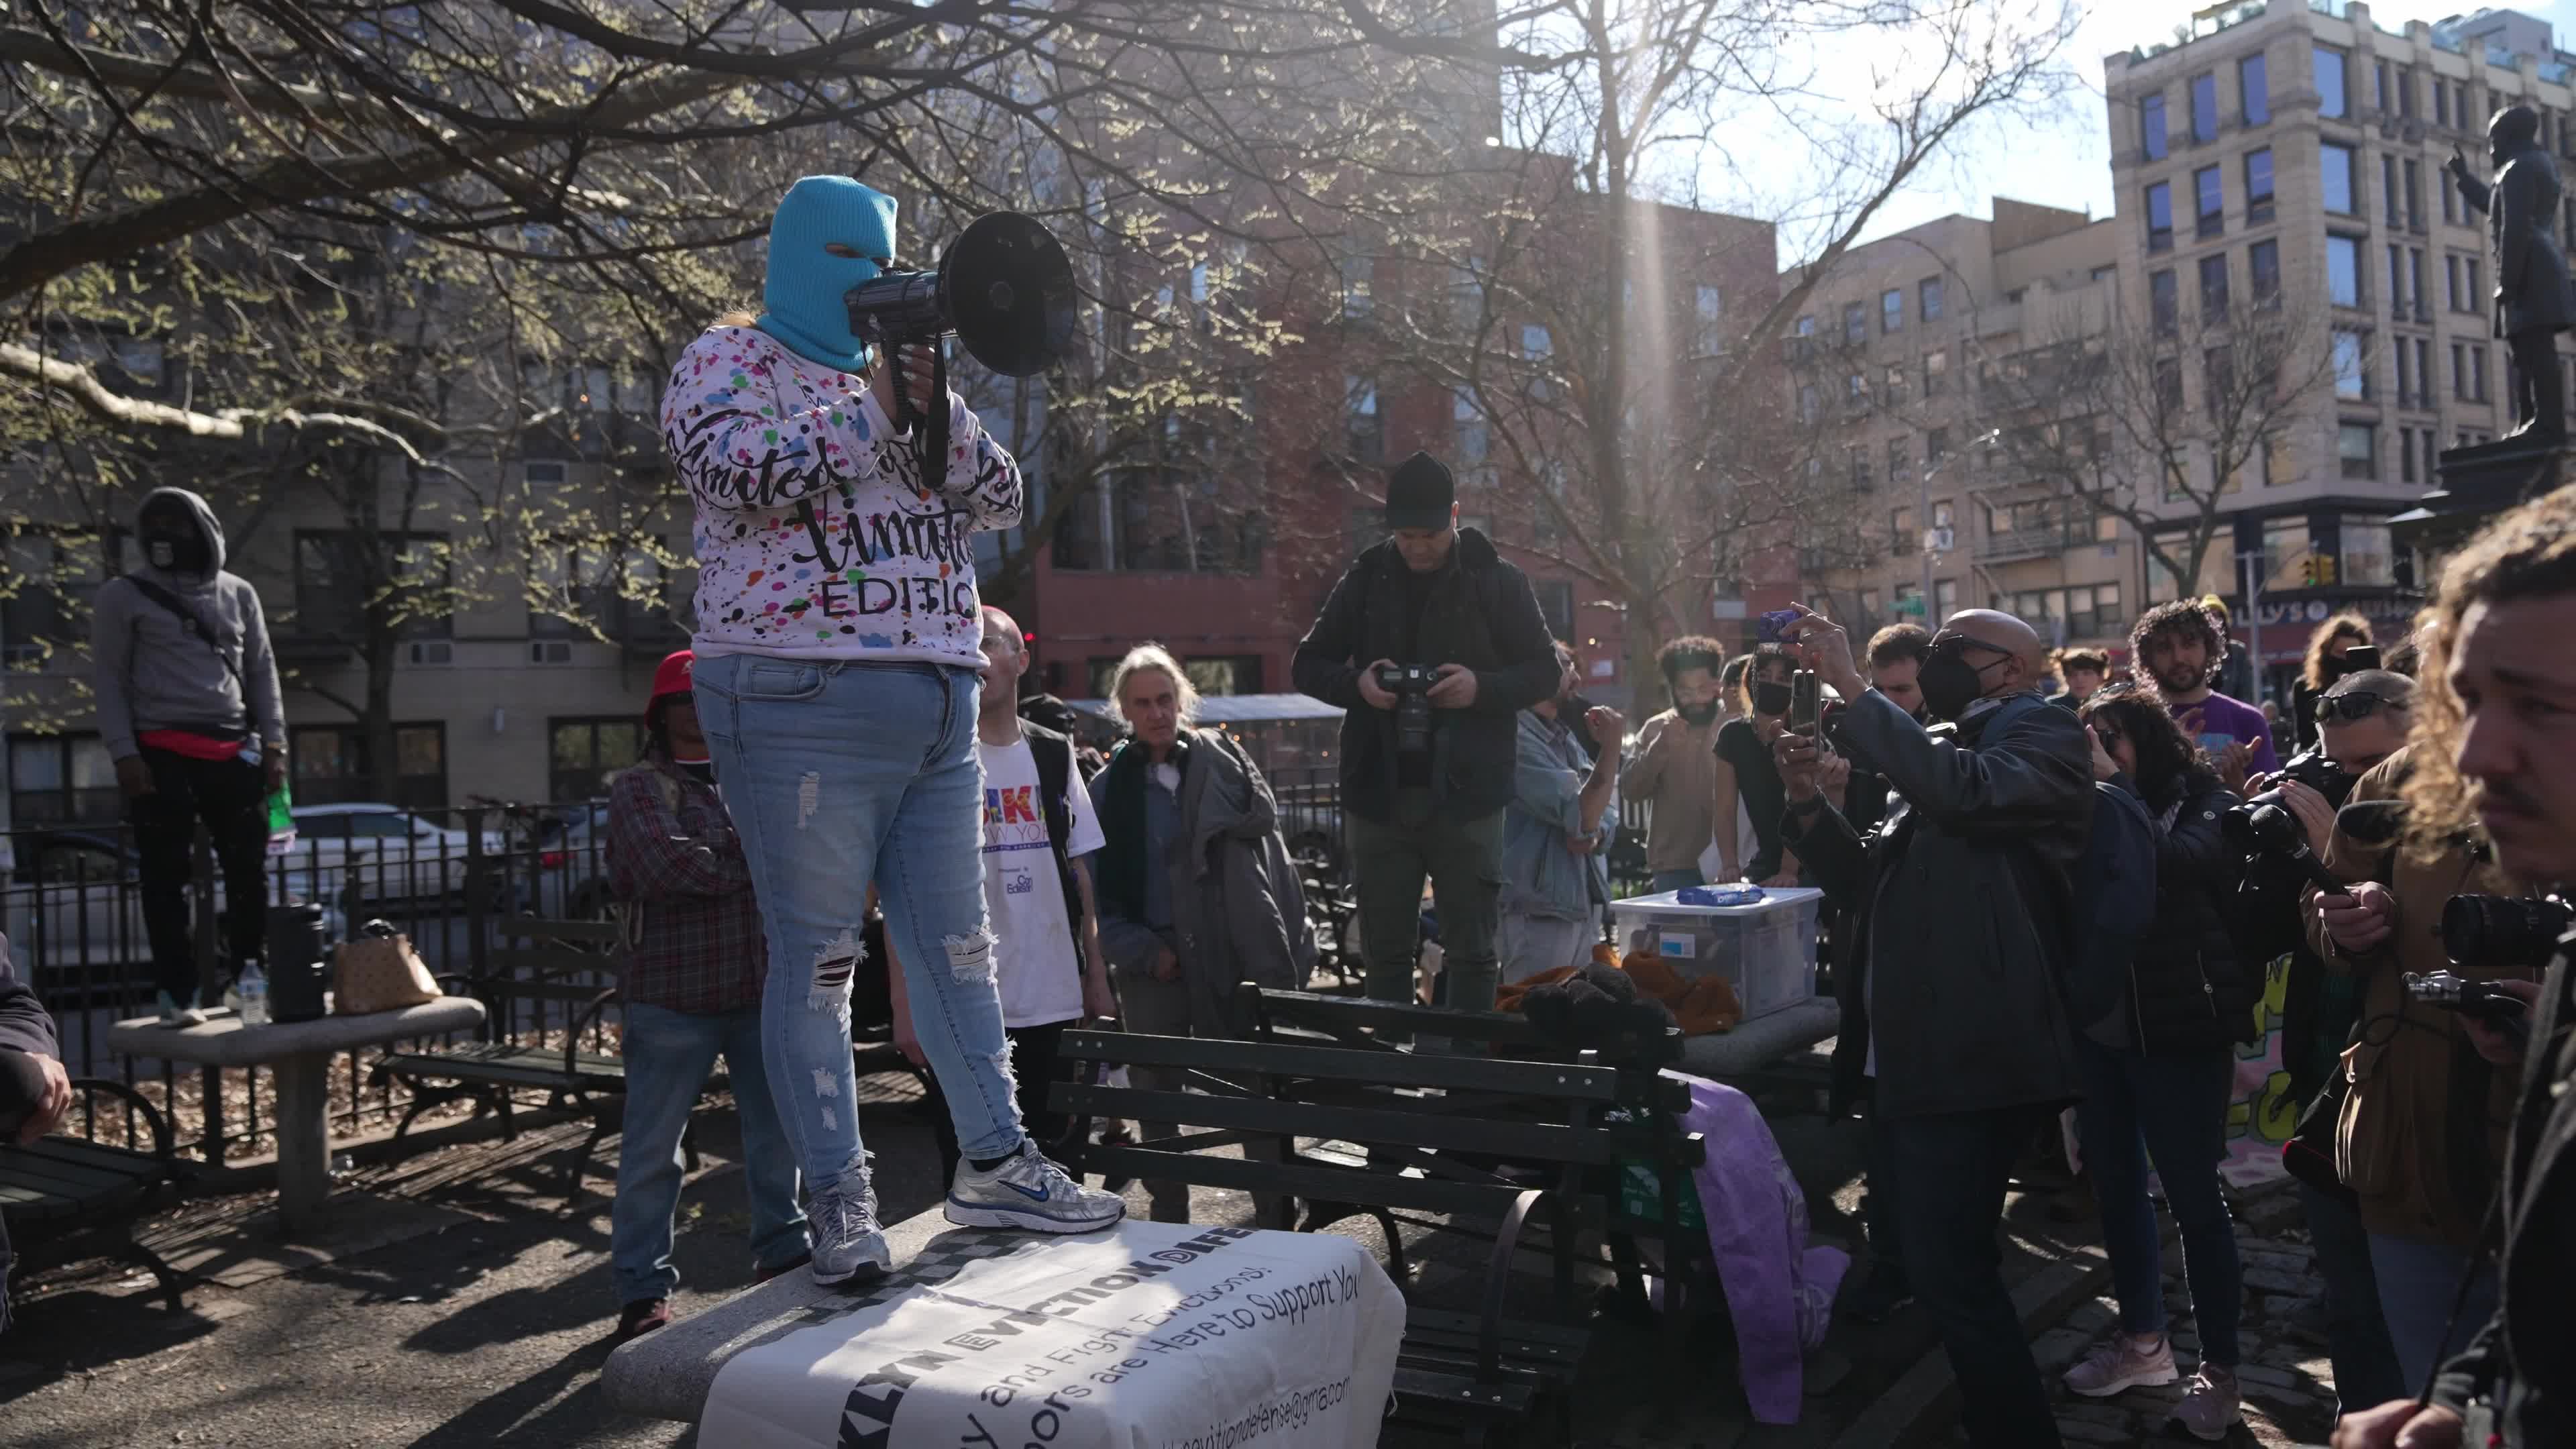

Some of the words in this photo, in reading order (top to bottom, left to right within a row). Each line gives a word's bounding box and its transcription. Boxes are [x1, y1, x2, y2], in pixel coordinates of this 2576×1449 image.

[942, 1261, 1174, 1352] EVICTION
[980, 1363, 1055, 1407] and
[1044, 1325, 1134, 1364] Fight
[1024, 1384, 1093, 1449] ors
[1089, 1356, 1148, 1384] are
[1136, 1322, 1226, 1354] Here
[1212, 1308, 1256, 1330] to
[1246, 1273, 1335, 1326] Support
